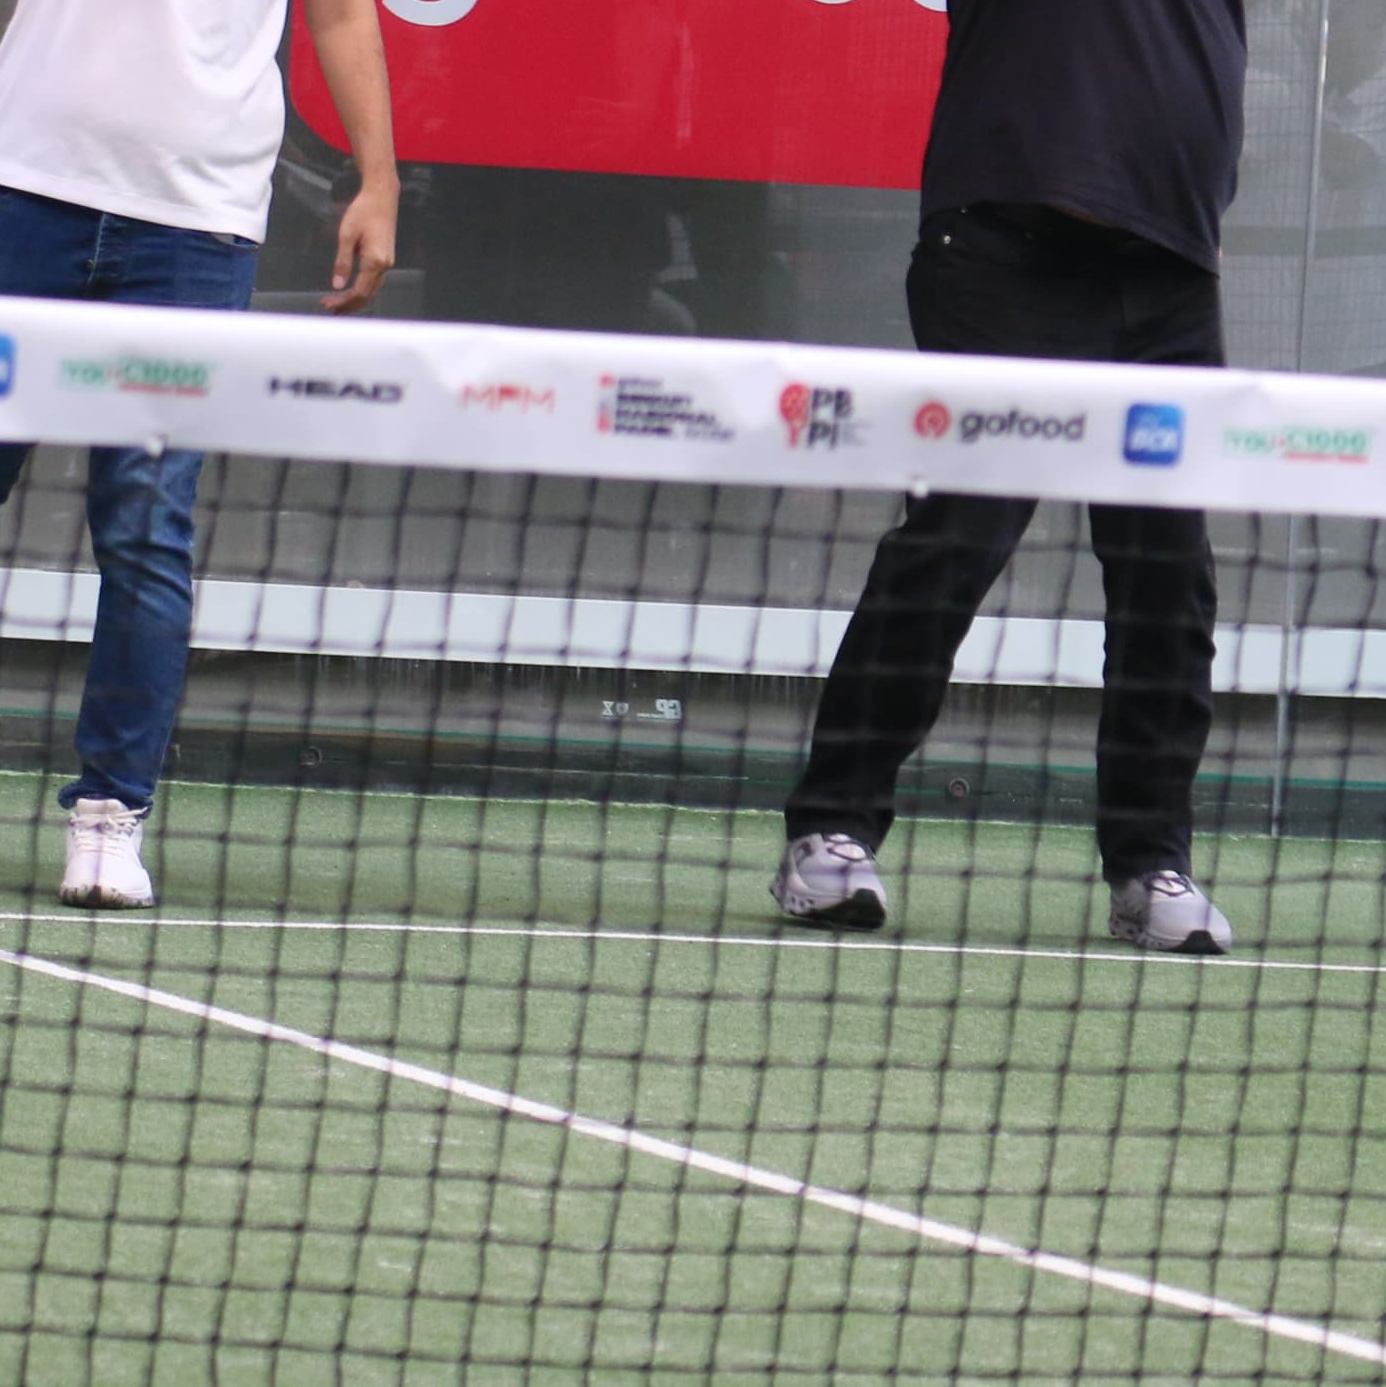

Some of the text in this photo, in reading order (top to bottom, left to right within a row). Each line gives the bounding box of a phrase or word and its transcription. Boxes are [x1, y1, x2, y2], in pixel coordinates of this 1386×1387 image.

[269, 375, 404, 404] HEAD
[812, 386, 853, 417] PB
[807, 420, 839, 451] PI
[959, 408, 1088, 446] gofood
